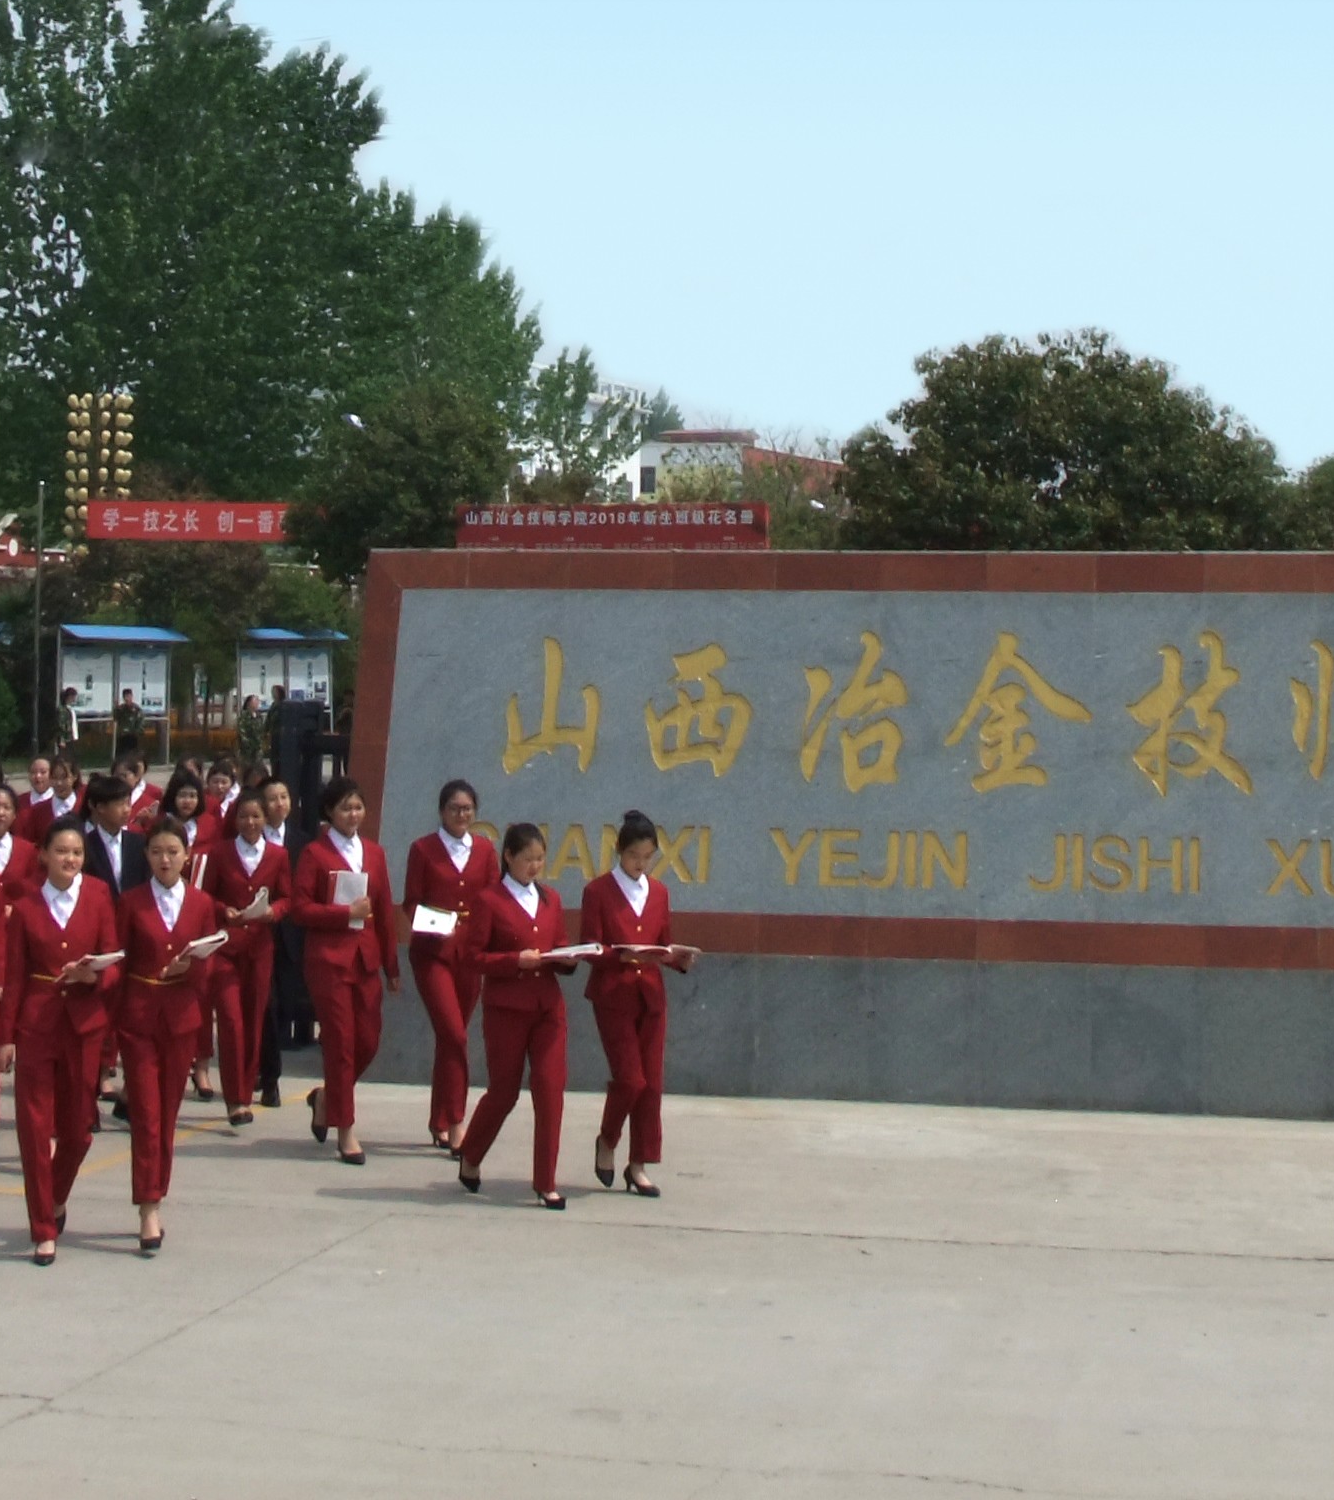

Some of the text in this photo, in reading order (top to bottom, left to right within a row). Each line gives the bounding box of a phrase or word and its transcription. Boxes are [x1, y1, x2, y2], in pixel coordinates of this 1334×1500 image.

[102, 508, 200, 533] 学一技之长
[769, 826, 968, 889] YEJIN
[1028, 833, 1202, 896] JISHI
